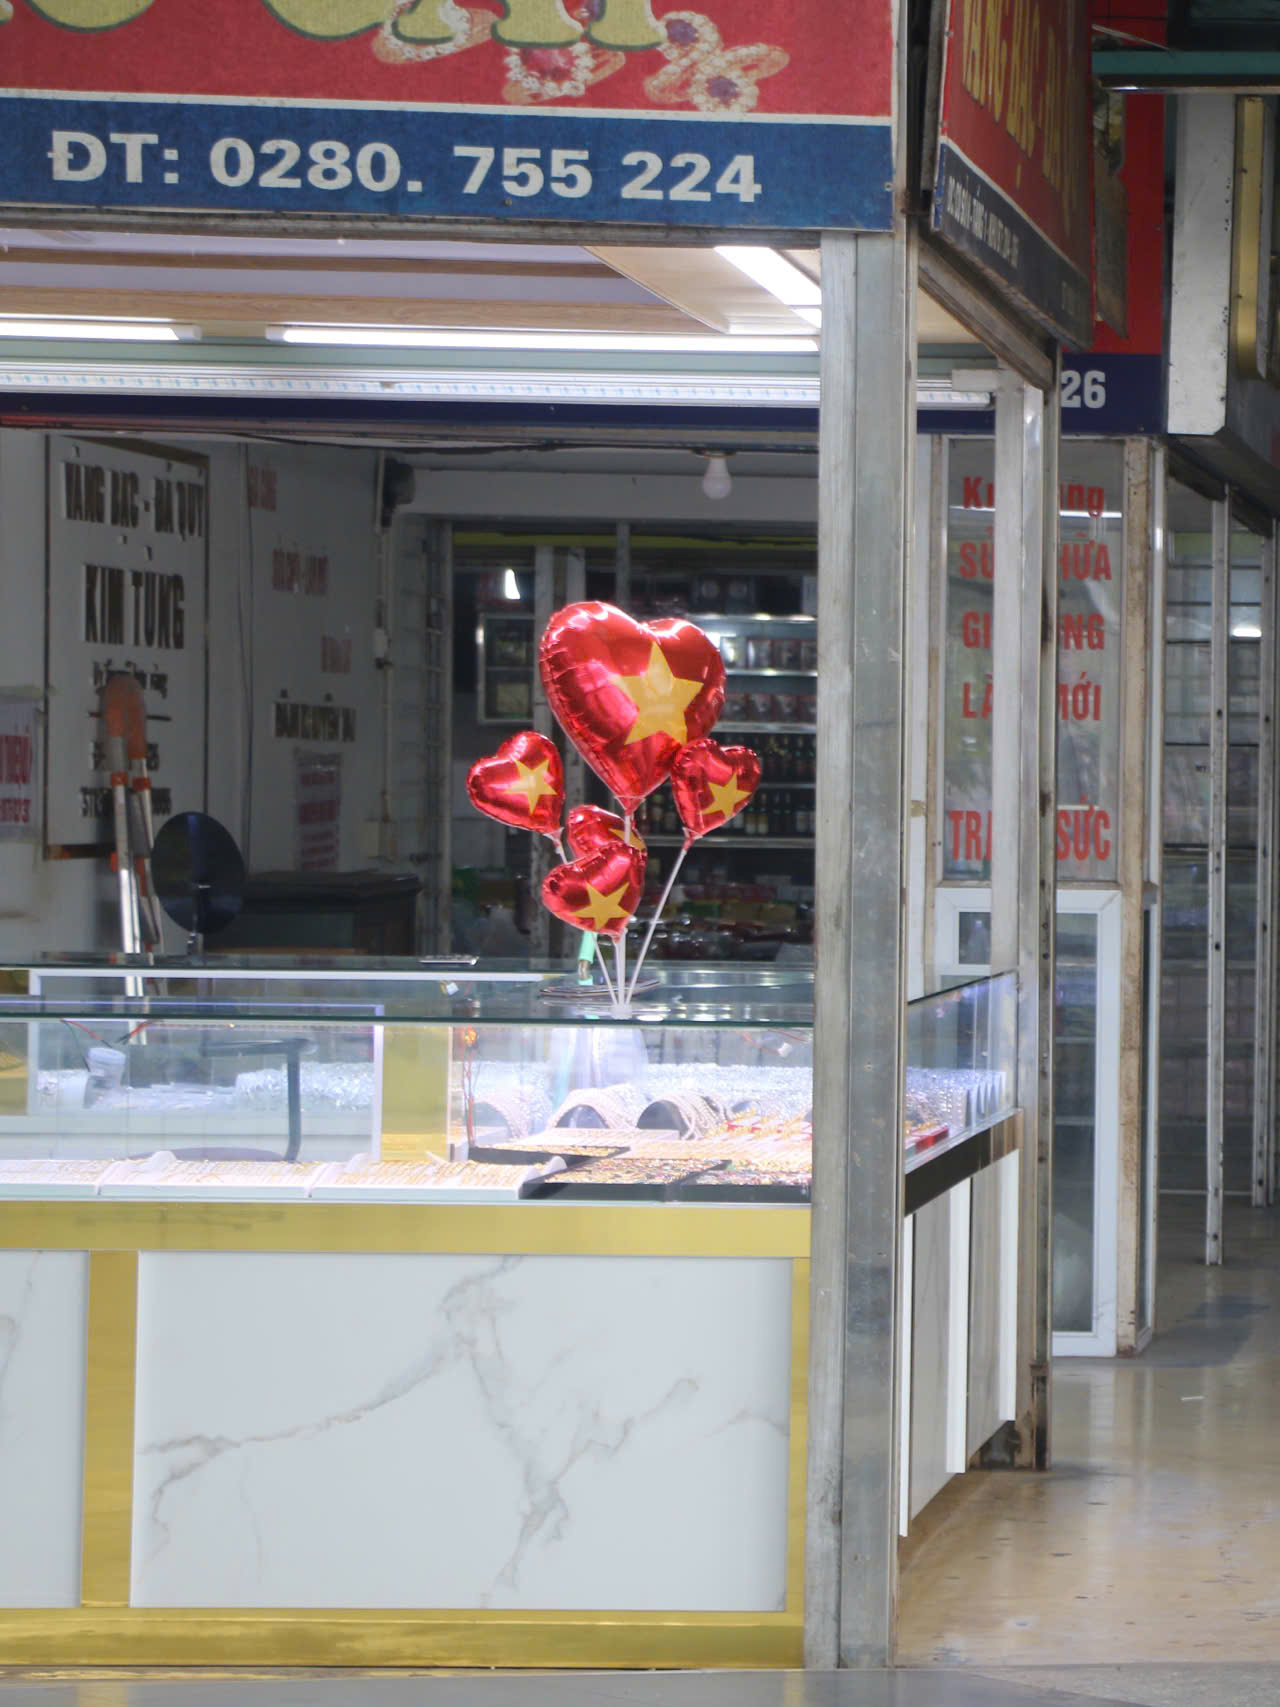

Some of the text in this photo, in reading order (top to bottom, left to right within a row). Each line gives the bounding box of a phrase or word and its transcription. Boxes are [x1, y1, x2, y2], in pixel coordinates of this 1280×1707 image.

[48, 130, 763, 203] ĐT: 0280. 755 224
